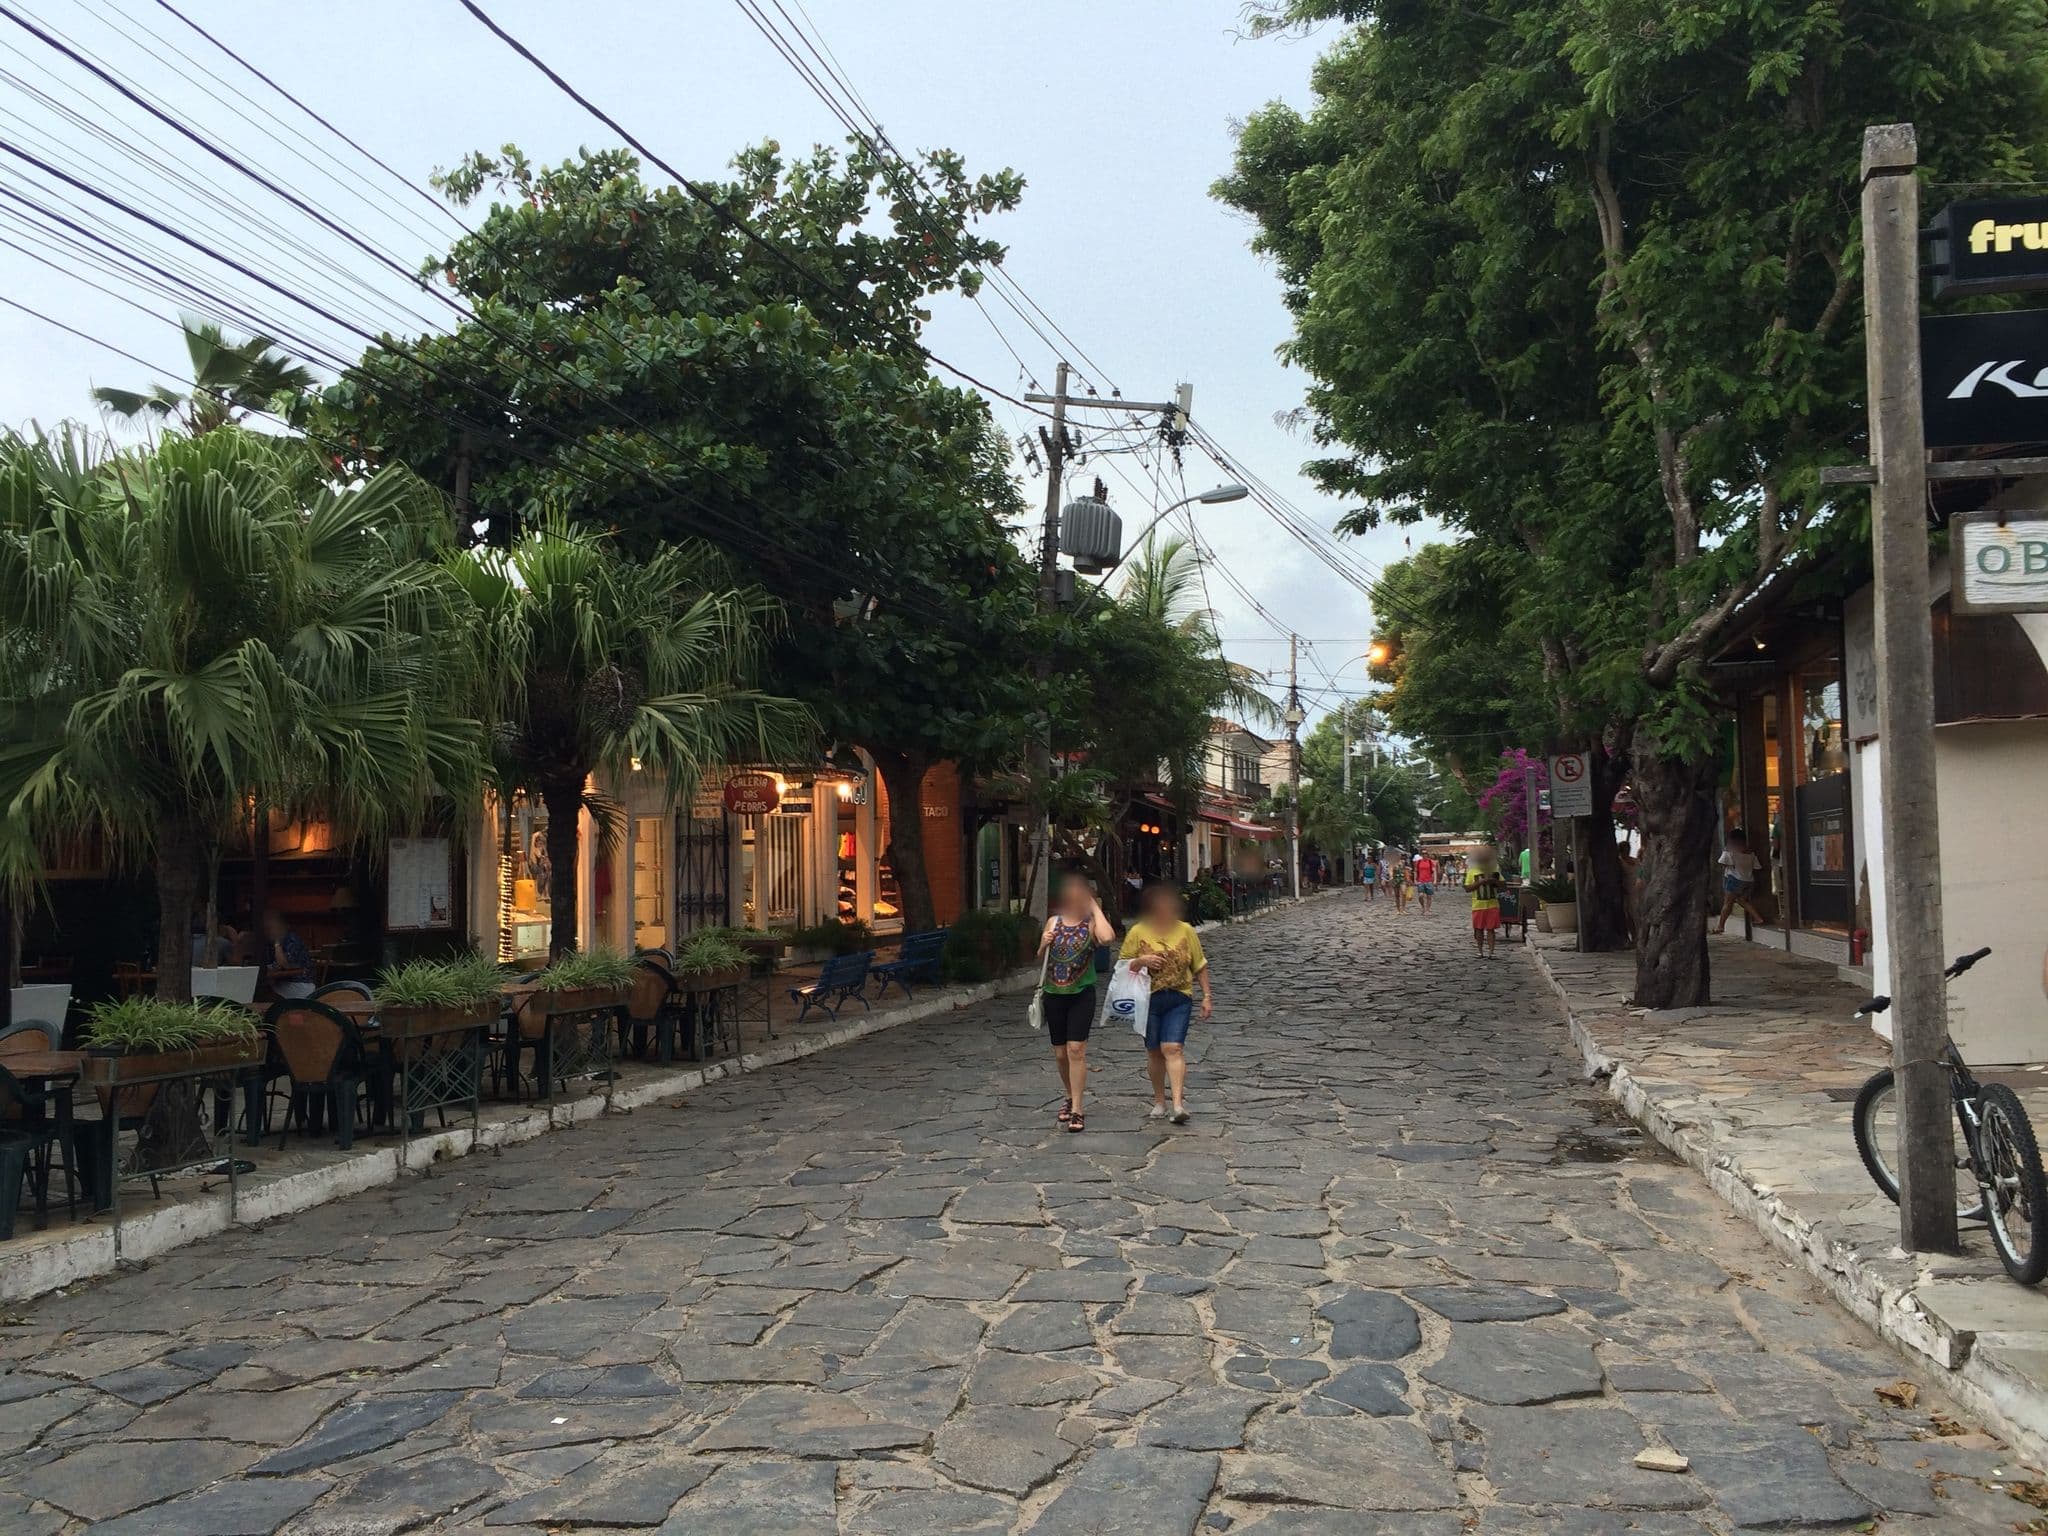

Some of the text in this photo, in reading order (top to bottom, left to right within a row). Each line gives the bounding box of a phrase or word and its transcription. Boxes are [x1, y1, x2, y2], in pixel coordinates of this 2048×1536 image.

[1968, 219, 2048, 254] fru
[732, 776, 768, 788] GALERIA
[743, 790, 759, 799] DAS
[733, 801, 768, 812] PEDRAS
[923, 806, 949, 818] TACO
